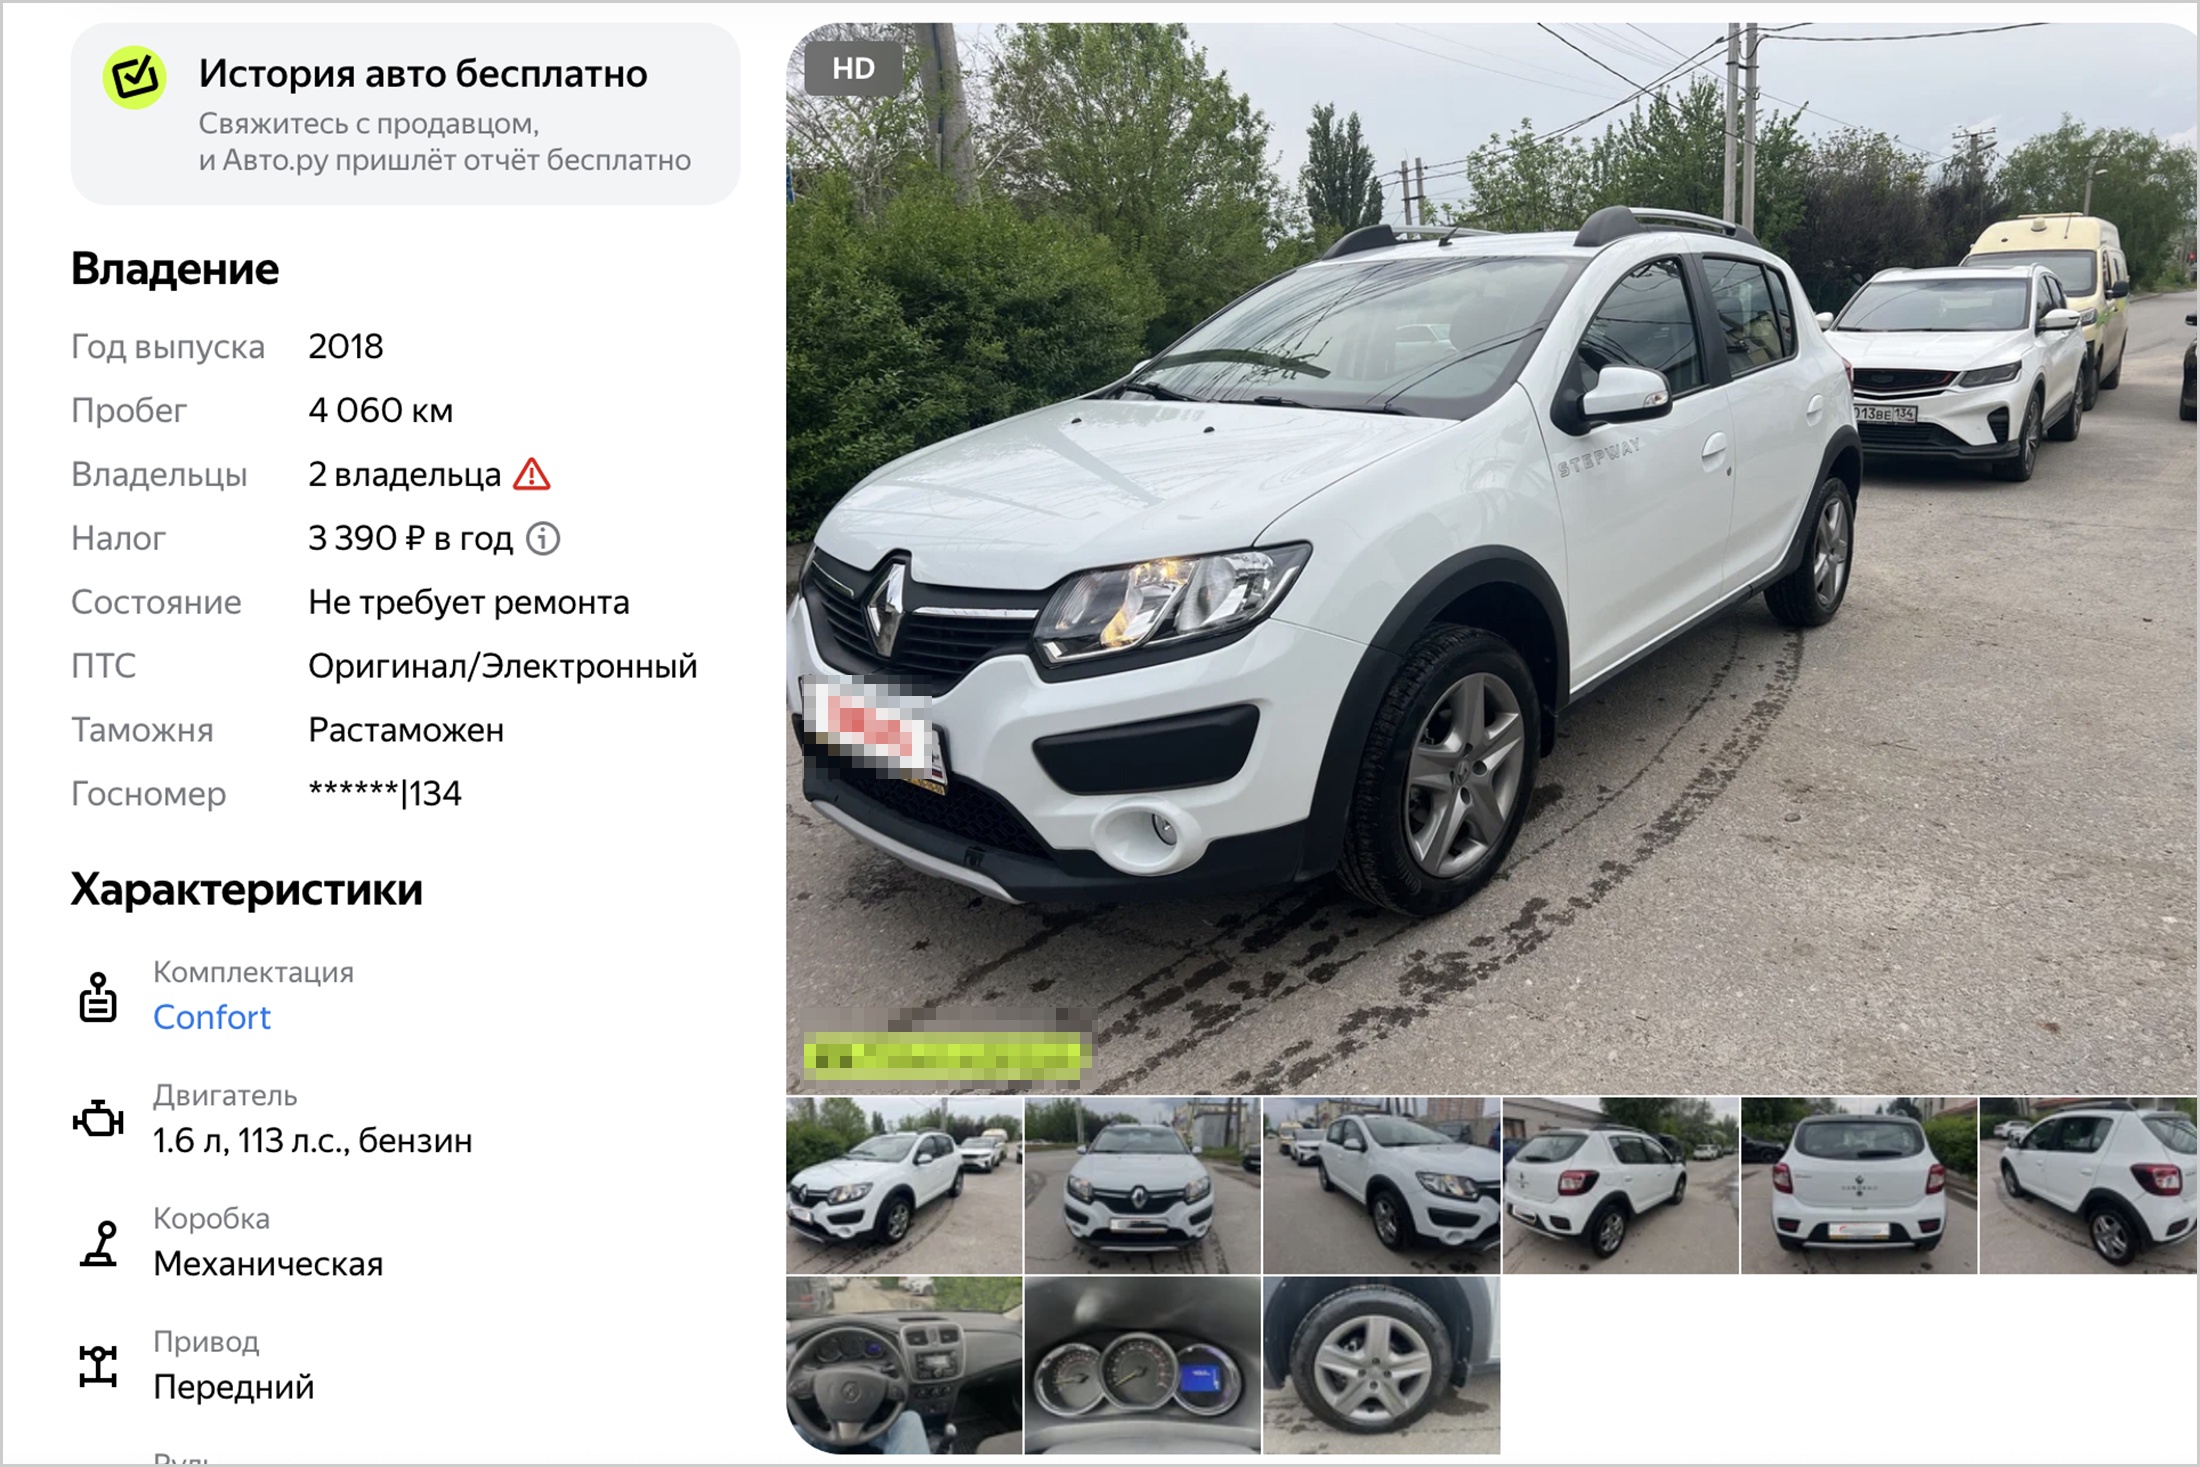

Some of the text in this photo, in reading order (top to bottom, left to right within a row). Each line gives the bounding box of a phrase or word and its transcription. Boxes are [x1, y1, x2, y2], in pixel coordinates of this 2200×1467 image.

[201, 57, 647, 94] История авто бесплатно
[199, 112, 539, 139] Свяжитесь с продавцом,
[200, 147, 691, 176] и Авто.ру пришлёт отчёт бесплатно
[72, 251, 279, 291] Владение
[73, 333, 264, 365] Год выпуска
[309, 333, 383, 359] 2018
[73, 396, 187, 428] Пробег
[309, 397, 452, 423] 4 060 км
[1895, 408, 1913, 418] 134
[1558, 437, 1640, 478] STEPWAY
[73, 461, 246, 491] Владельцы
[309, 461, 500, 492] 2 владельца
[73, 525, 166, 550] Налог
[309, 524, 514, 556] 3 390 ₽ в год
[72, 589, 241, 614] Состояние
[310, 587, 629, 621] Не требует ремонта
[73, 652, 135, 678] ПТС
[309, 651, 696, 684] Оригинал/Электронный
[72, 716, 212, 742] Таможня
[310, 716, 503, 742] Растаможен
[73, 780, 226, 812] Госномер
[70, 871, 422, 913] Характеристики
[155, 960, 353, 987] Комплектация
[154, 1004, 271, 1030] Confort
[153, 1084, 297, 1111] Двигатель
[154, 1126, 471, 1156] 1.6 л, 113 л.с., бензин
[155, 1206, 269, 1234] Коробка
[155, 1250, 382, 1276] Механическая
[155, 1330, 259, 1357] Привод
[155, 1373, 313, 1405] Передний
